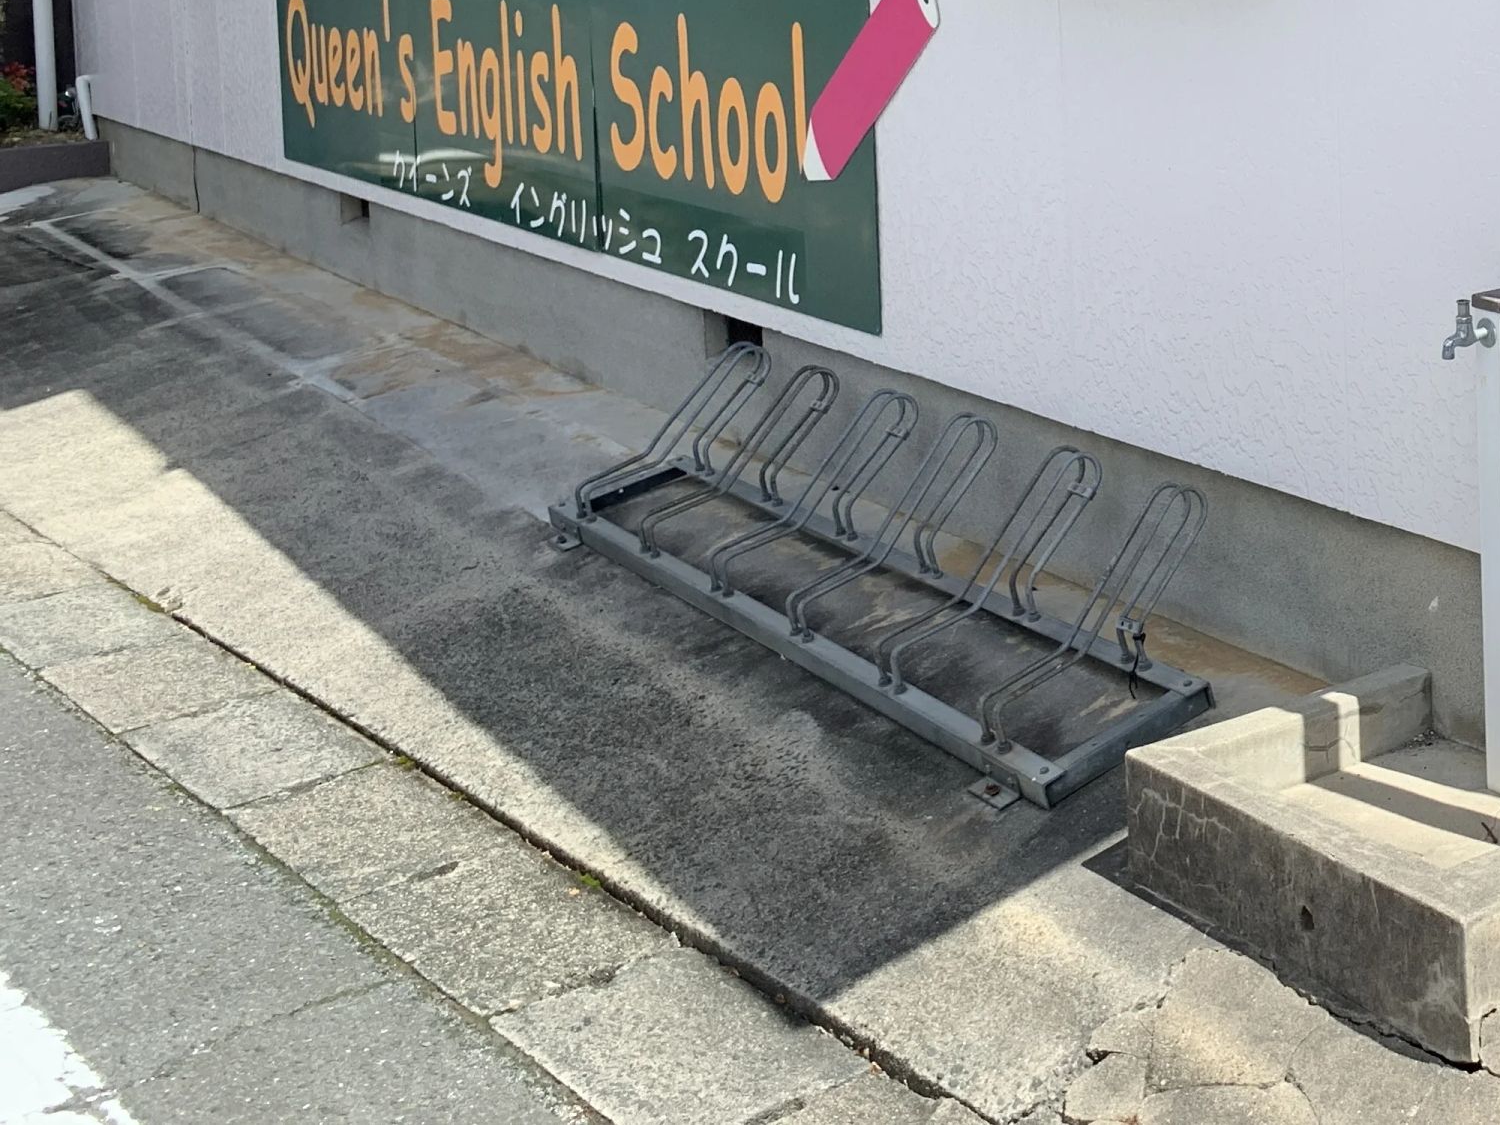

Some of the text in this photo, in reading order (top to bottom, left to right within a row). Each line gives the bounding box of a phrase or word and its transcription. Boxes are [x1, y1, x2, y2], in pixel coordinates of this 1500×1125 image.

[610, 12, 806, 203] School
[393, 150, 799, 305] クイーンズ イングリッシュ スクール
